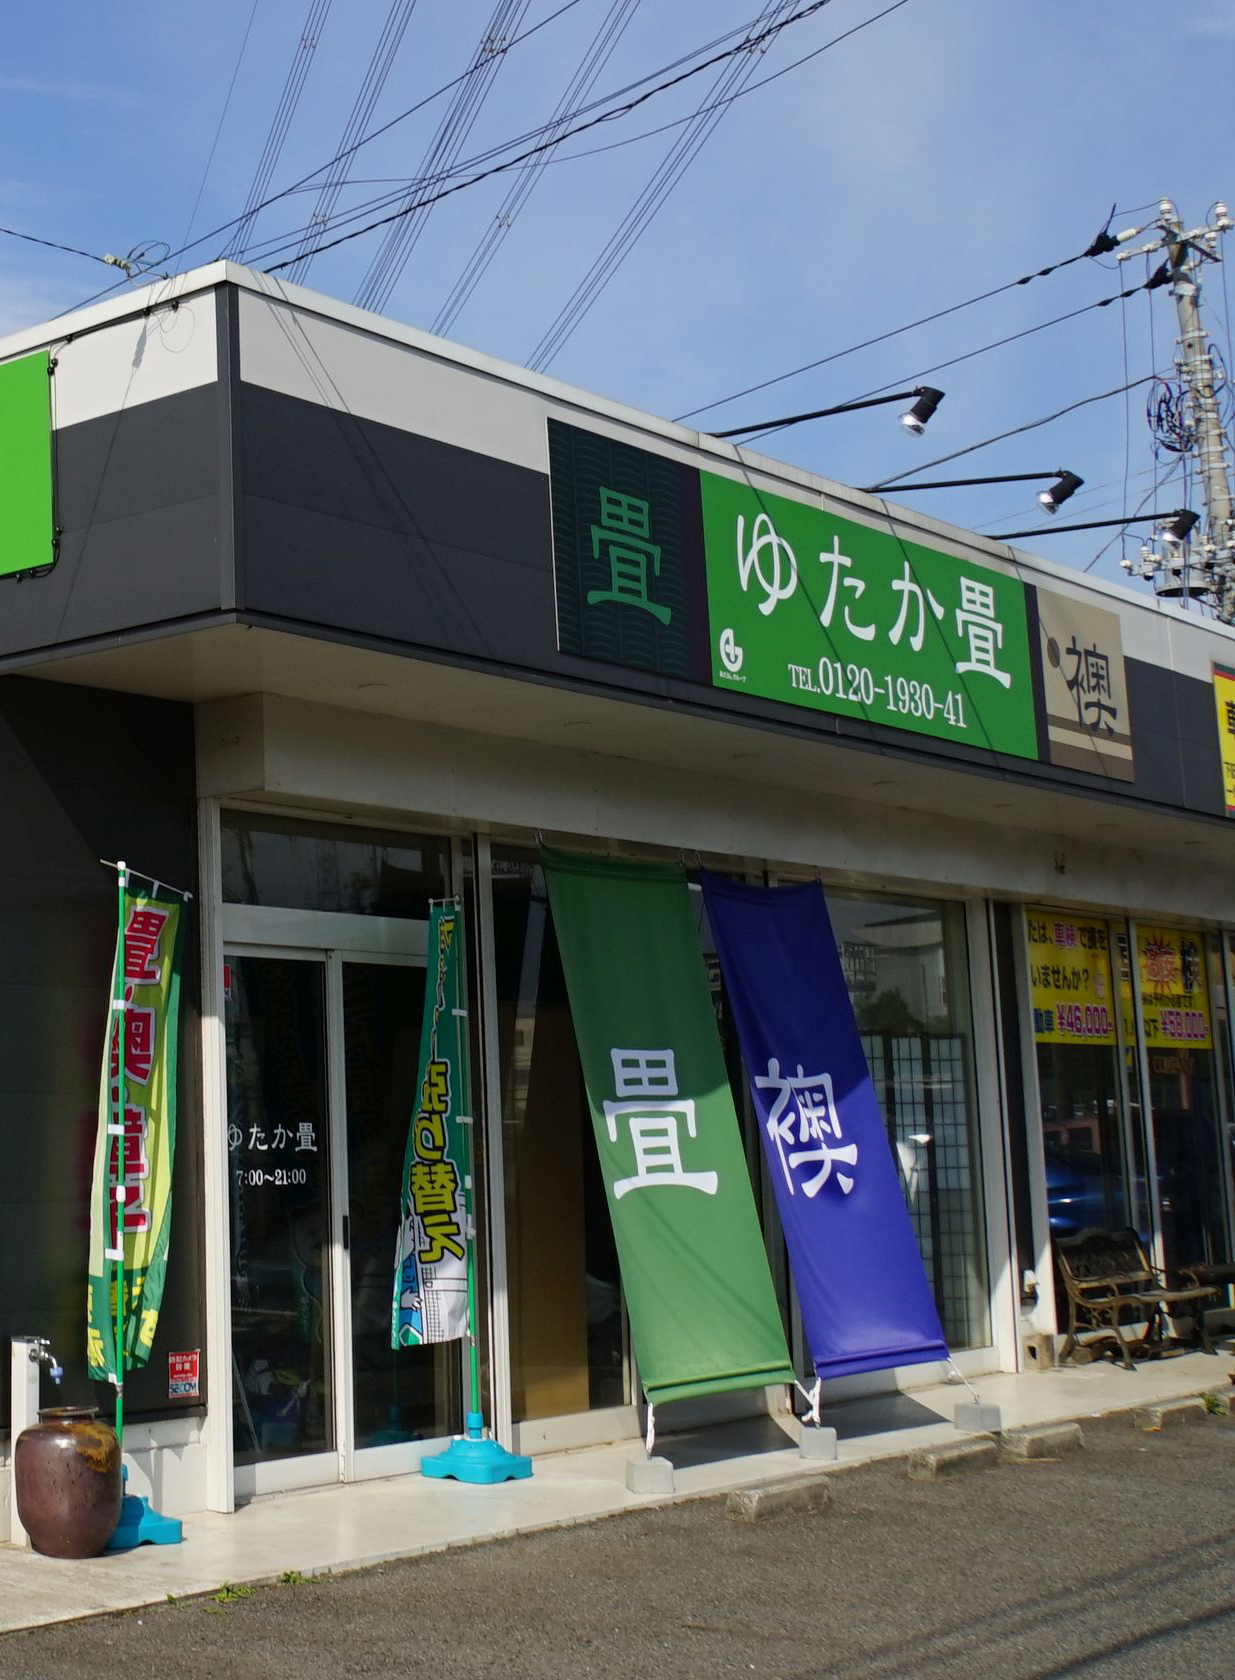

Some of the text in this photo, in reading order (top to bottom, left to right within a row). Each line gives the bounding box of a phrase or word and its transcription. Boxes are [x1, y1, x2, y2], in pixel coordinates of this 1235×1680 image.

[586, 486, 673, 625] 畳
[736, 512, 1013, 690] ゆたか畳
[227, 1122, 318, 1152] ゆたか畳
[602, 1048, 719, 1200] 畳
[755, 1056, 859, 1199] 襖
[169, 1382, 197, 1393] SECOM
